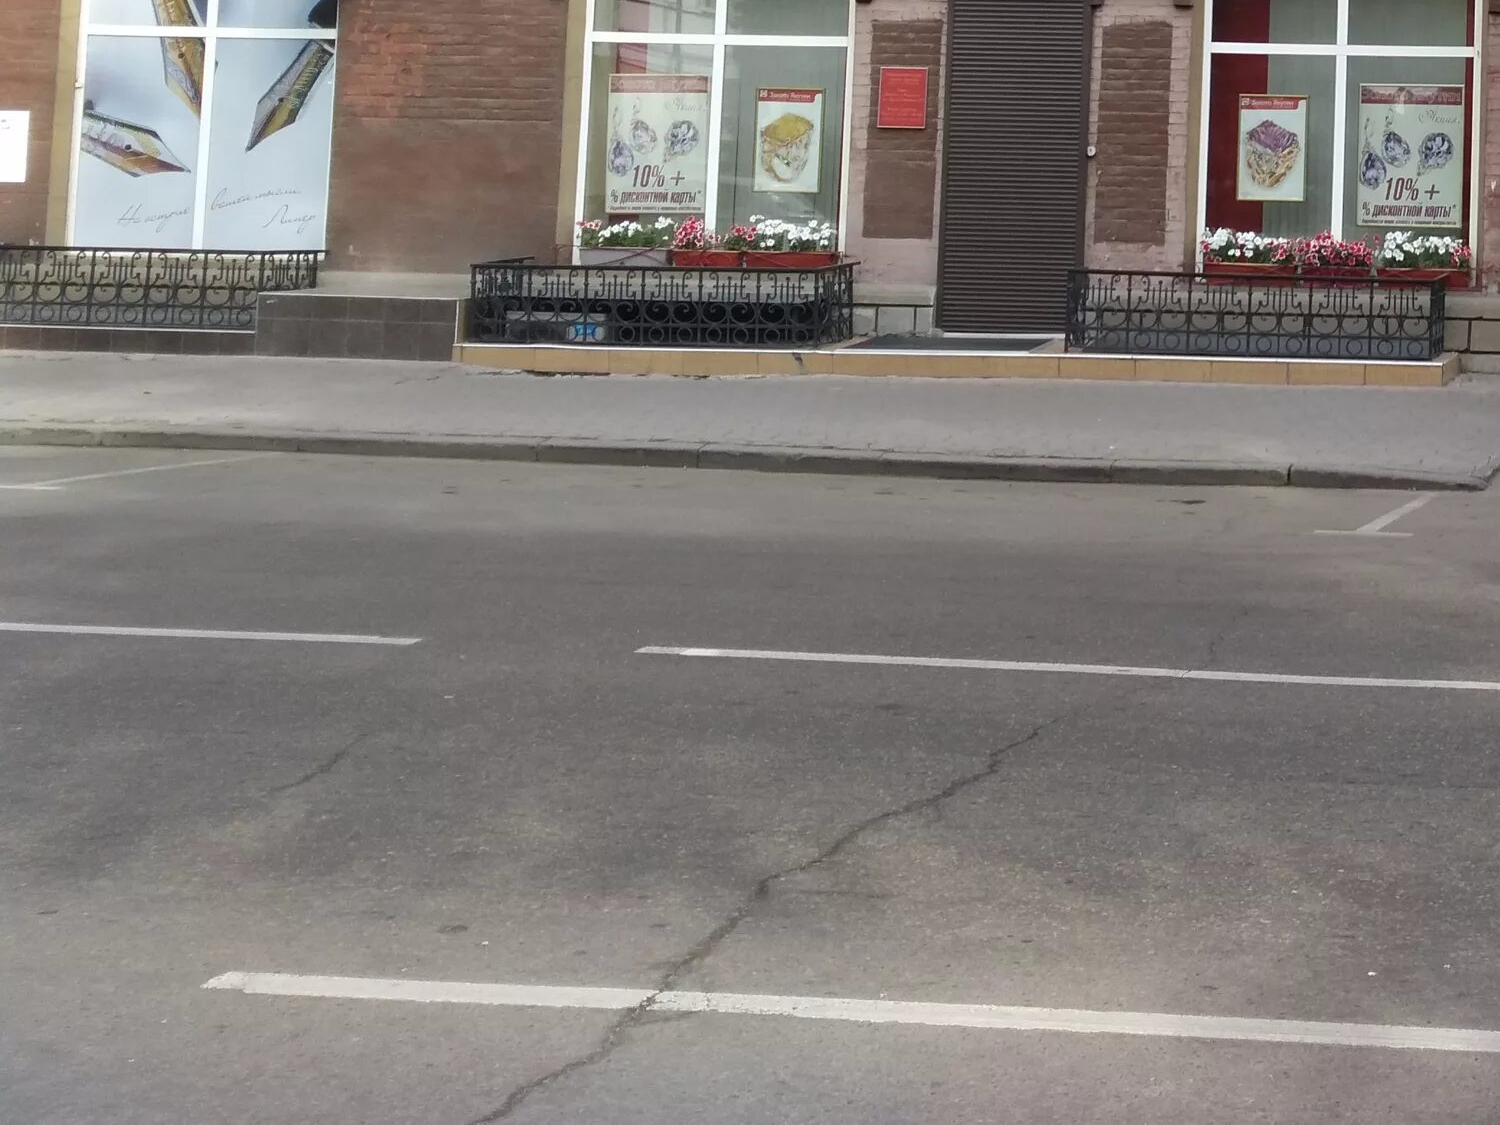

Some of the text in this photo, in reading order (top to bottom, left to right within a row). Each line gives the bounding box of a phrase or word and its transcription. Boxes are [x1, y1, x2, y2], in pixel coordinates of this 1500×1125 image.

[632, 164, 686, 188] 10% +
[620, 188, 668, 205] дисконтной
[1385, 177, 1440, 201] 10% +
[1371, 202, 1423, 218] дисконтной
